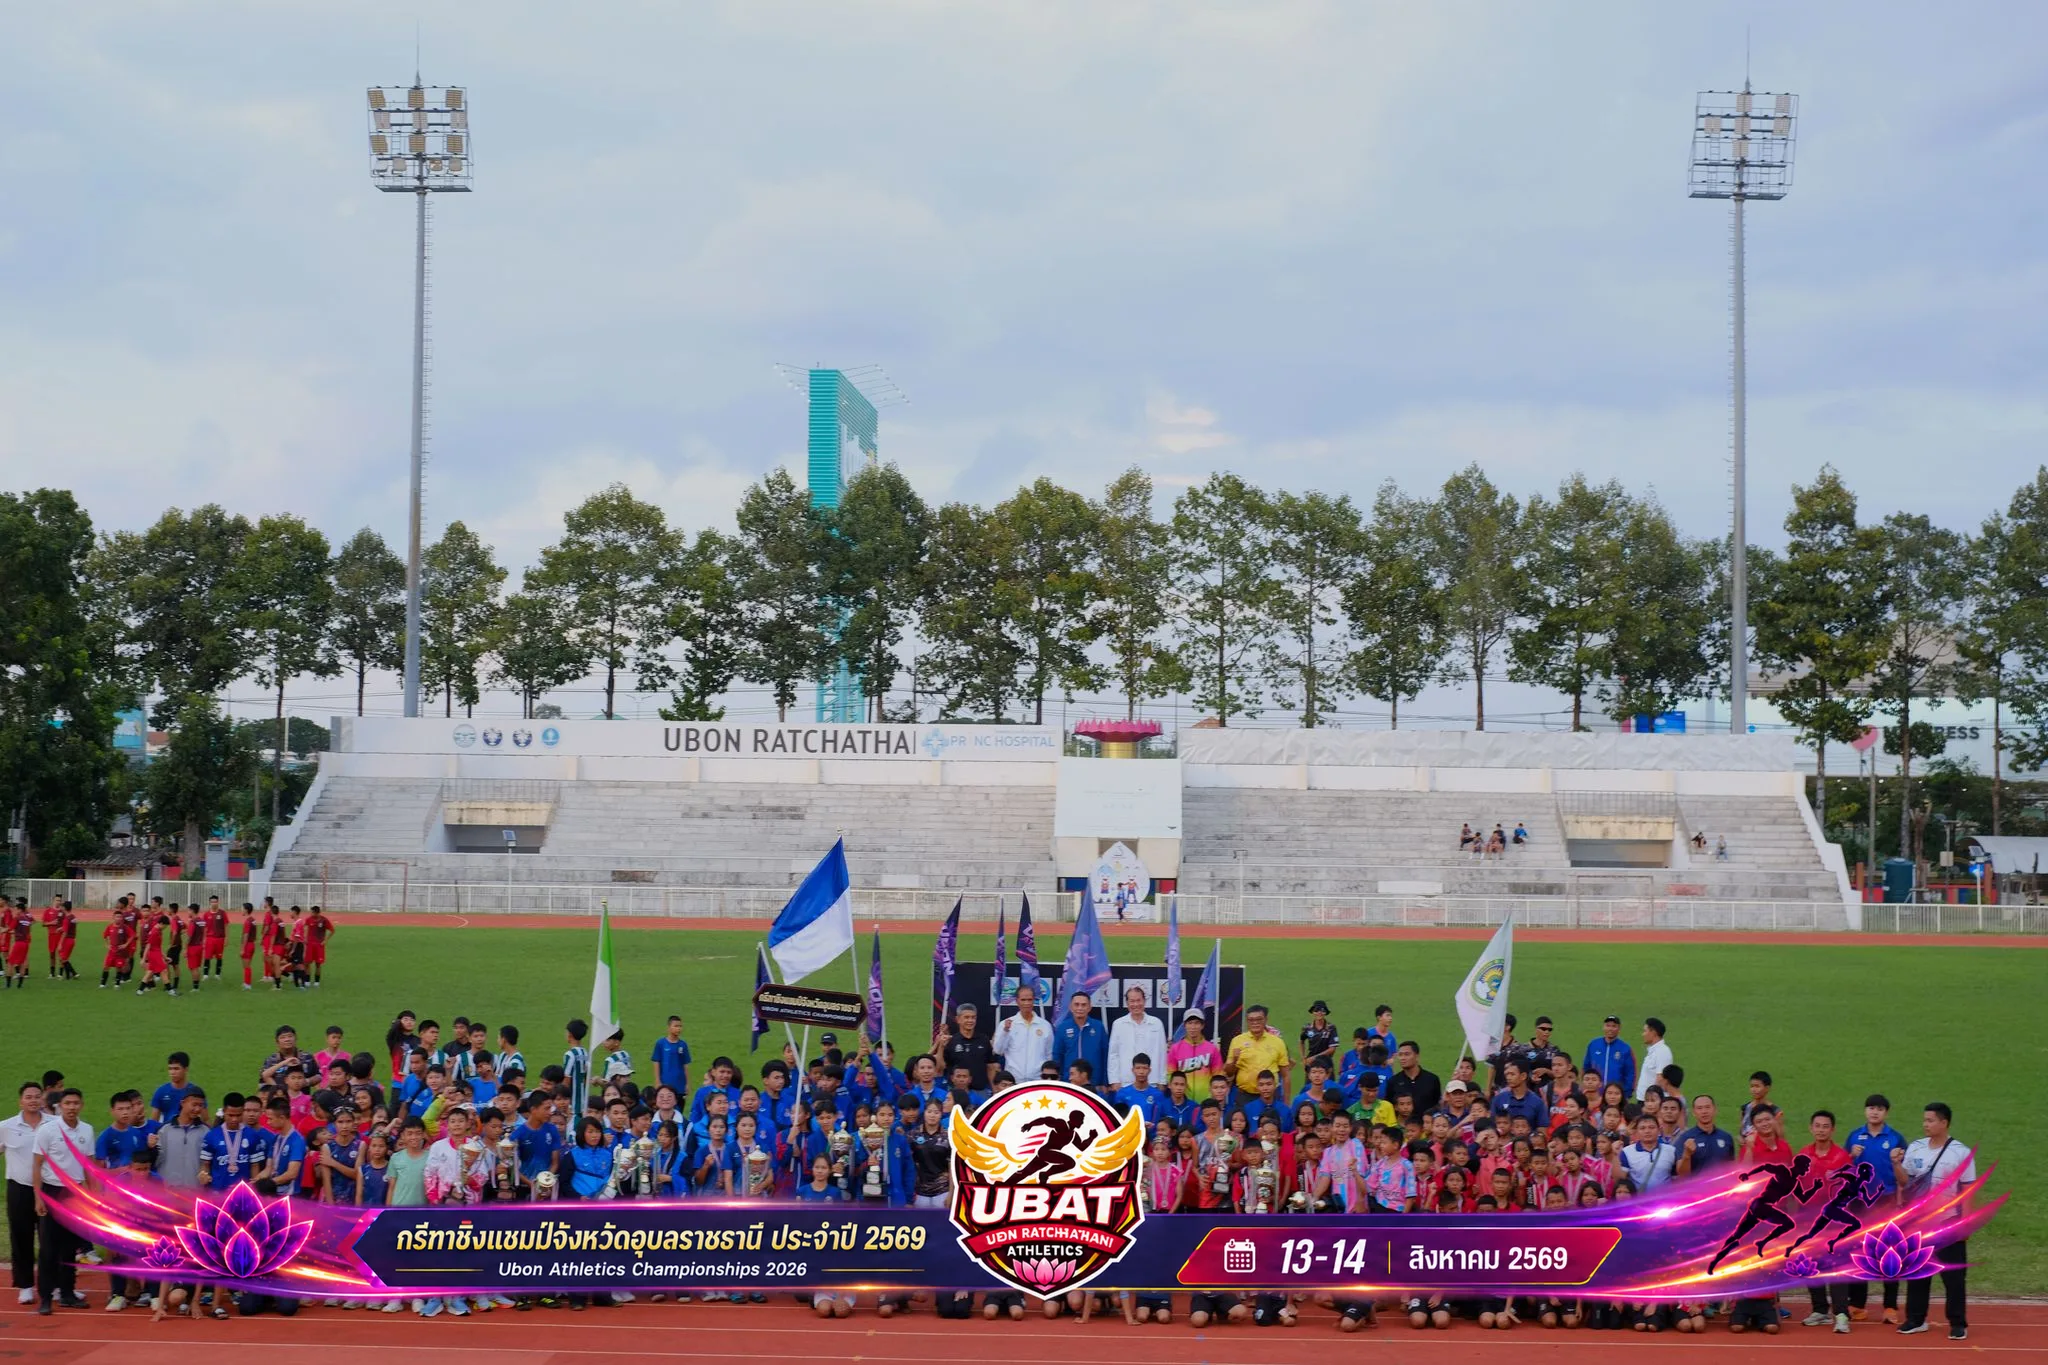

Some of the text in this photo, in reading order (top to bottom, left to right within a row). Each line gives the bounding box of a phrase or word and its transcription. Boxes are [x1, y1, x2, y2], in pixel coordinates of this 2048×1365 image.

[664, 727, 916, 754] UBON RATCHATHA
[995, 735, 1056, 747] HOSPITAL
